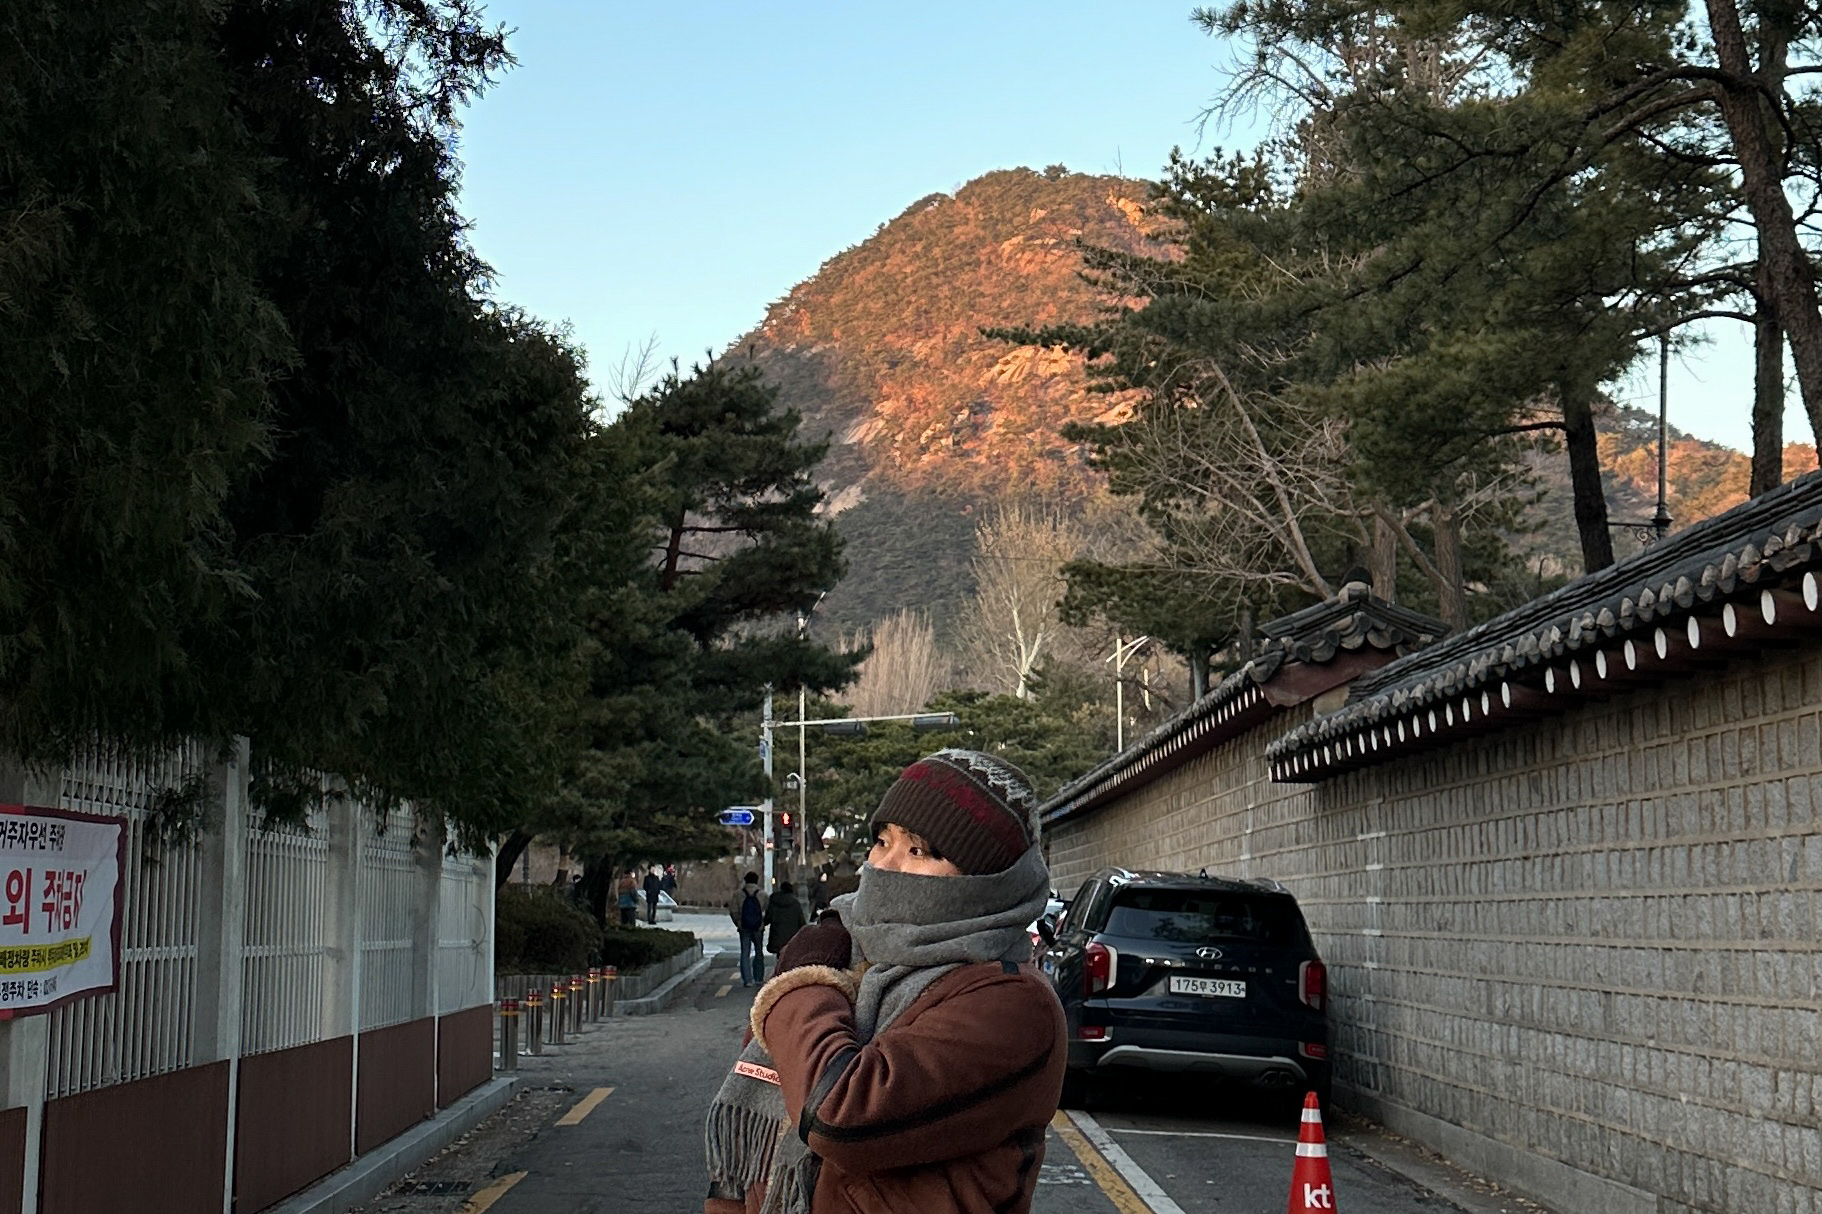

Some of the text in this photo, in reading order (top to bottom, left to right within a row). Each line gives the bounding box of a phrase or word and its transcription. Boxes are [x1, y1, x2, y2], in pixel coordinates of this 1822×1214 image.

[3, 868, 87, 934] 외 주차금지
[1304, 1183, 1331, 1208] kt
